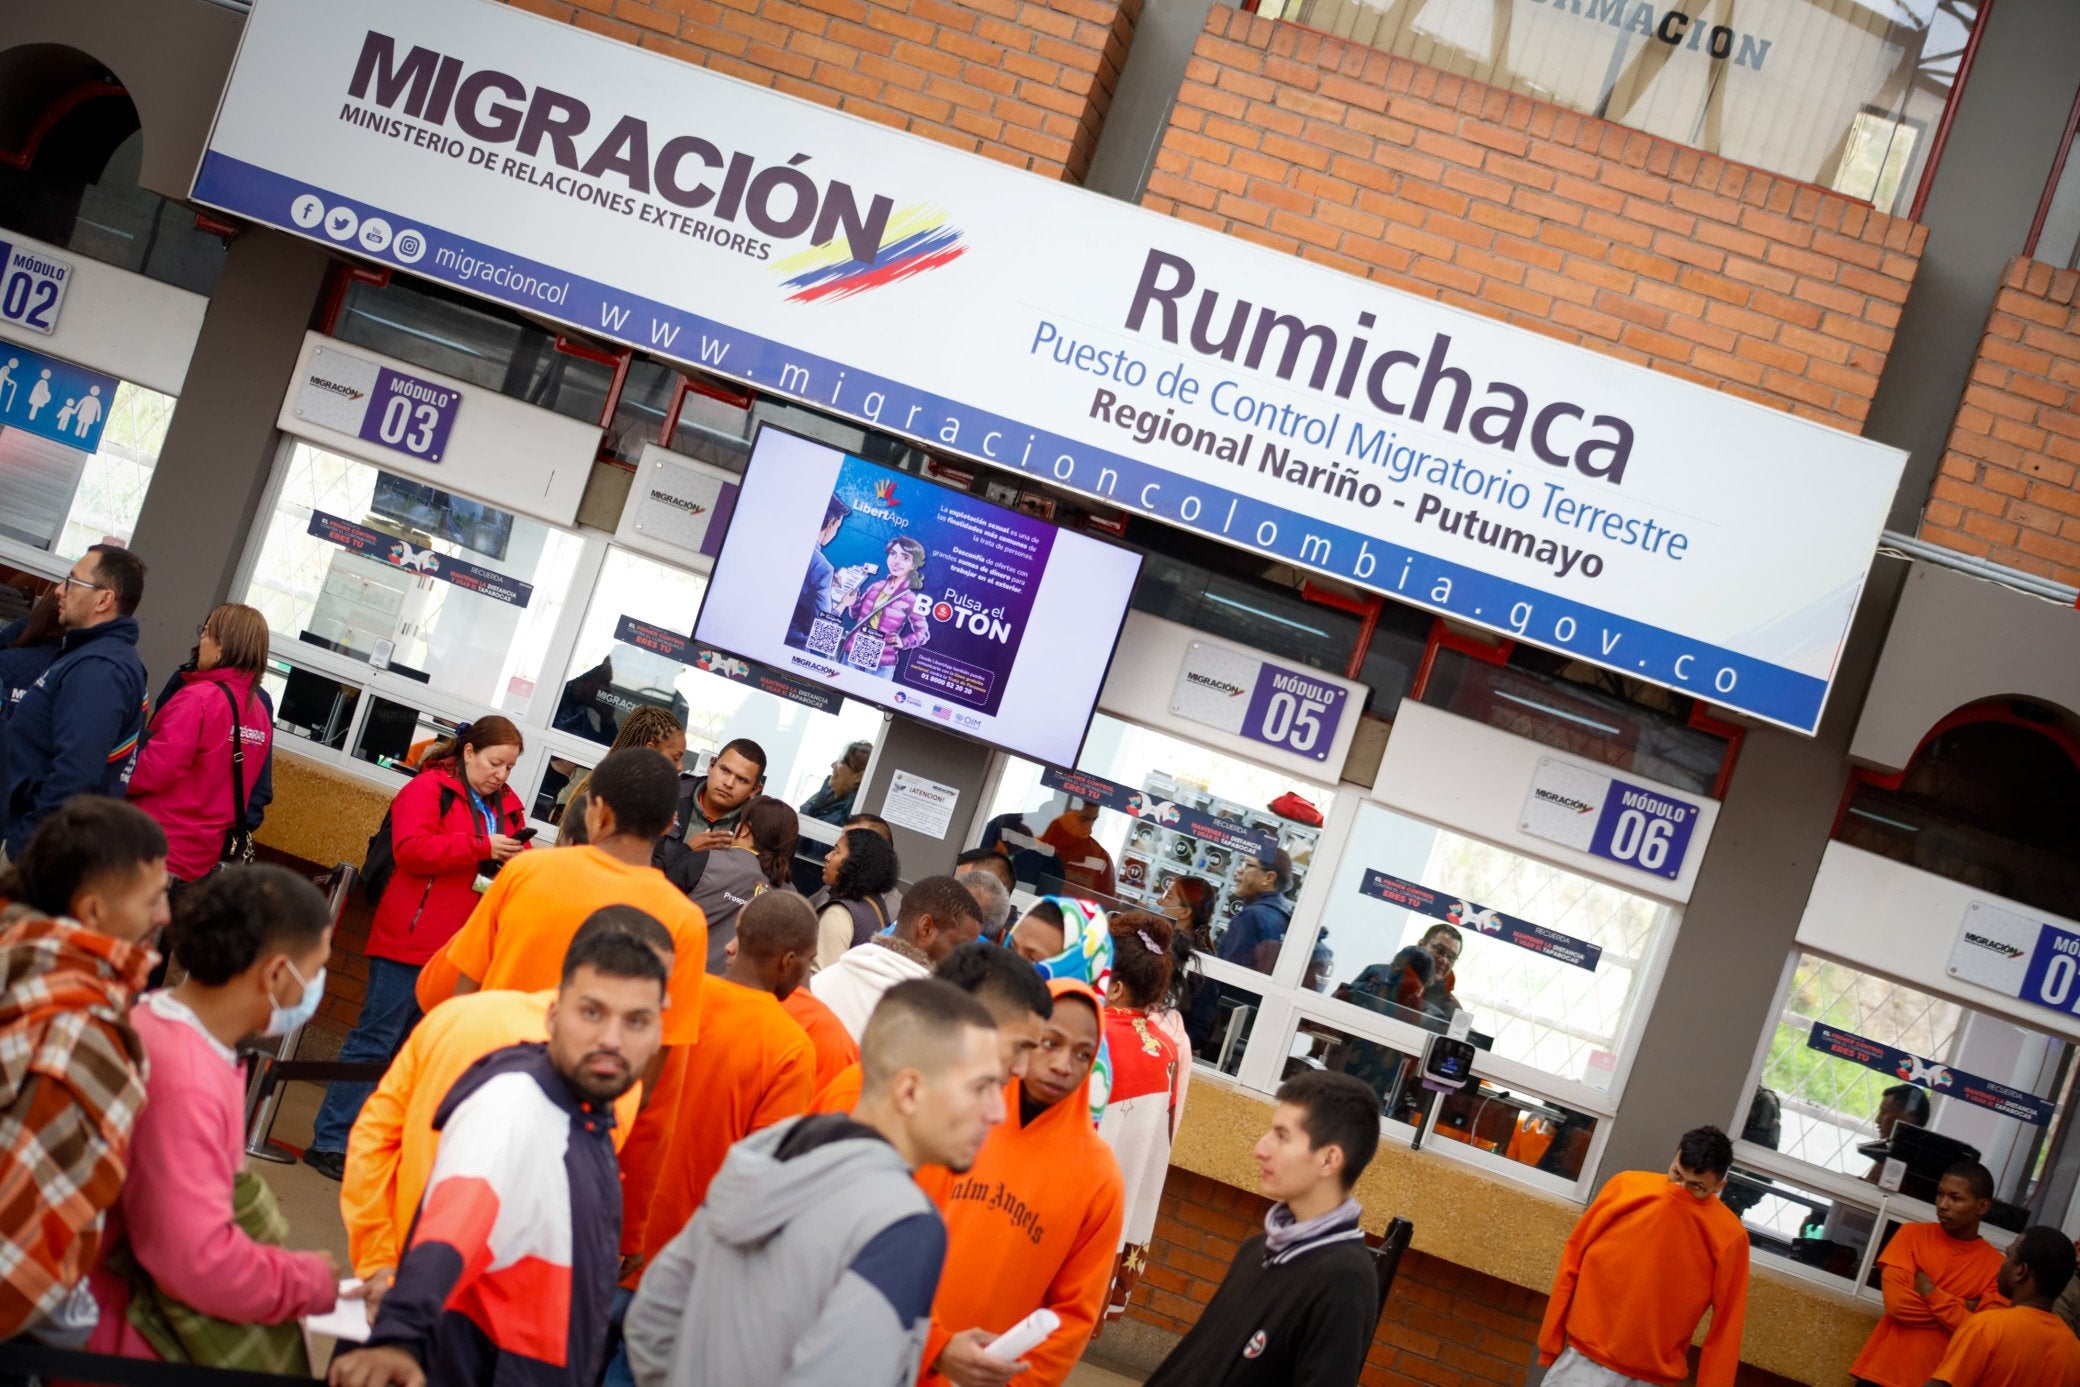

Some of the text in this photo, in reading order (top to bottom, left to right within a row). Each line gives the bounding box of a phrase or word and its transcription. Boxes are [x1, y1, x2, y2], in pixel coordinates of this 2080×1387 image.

[348, 31, 894, 265] MIGRACIÓN
[339, 104, 771, 263] MINISTERIO DE RELACIONES EXTERIORES
[13, 254, 65, 282] MÓDULO
[435, 246, 570, 305] migracioncol
[2, 271, 58, 329] 02
[1125, 247, 1634, 485] Rumichaca
[310, 376, 358, 398] MIGRACIÓN
[390, 377, 448, 408] MÓDULO
[380, 395, 439, 453] 03
[1031, 320, 1689, 562] Puesto de Control Migratorio Terrestre
[1090, 389, 1251, 466] Regional
[1259, 445, 1382, 509] Nariño
[1415, 493, 1604, 579] Putumayo
[650, 489, 700, 511] MIGRACIÓN
[851, 499, 910, 529] LibertApp
[936, 513, 946, 521] las
[946, 516, 983, 534] finalidades
[983, 529, 998, 539] más
[998, 535, 1027, 549] comunes
[948, 507, 987, 527] explotación
[987, 521, 1010, 534] sexual
[1018, 533, 1030, 541] una
[1030, 536, 1040, 544] de
[328, 530, 351, 544] ERES
[979, 538, 994, 547] trata
[994, 542, 1003, 550] de
[1003, 546, 1033, 561] personas.
[931, 548, 1025, 586] grandes sumas de dinero para
[952, 546, 1028, 577] Desconfía de ofertas con
[470, 566, 503, 582] RECUERDA
[949, 564, 977, 580] trabajar
[977, 574, 986, 582] en
[994, 579, 1023, 594] exterior.
[476, 586, 510, 602] TAPABOCAS
[486, 583, 516, 598] DISTANCIA
[943, 588, 1006, 620] Pulsa el
[635, 635, 658, 649] ERES
[791, 656, 835, 676] MIGRACIÓN
[1187, 672, 1239, 693] MIGRACIÓN
[1272, 673, 1335, 705] MÓDULO
[787, 692, 822, 708] TAPABOCAS
[797, 689, 828, 704] DISTANCIA
[1262, 692, 1325, 751] 05
[1062, 781, 1086, 794] ERES
[1535, 788, 1587, 810] MIGRACIÓN
[1622, 790, 1685, 822] MÓDULO
[1212, 818, 1247, 835] RECUERDA
[1220, 838, 1256, 854] TAPABOCAS
[1229, 835, 1261, 850] DISTANCIA
[1610, 809, 1674, 869] 06
[1382, 889, 1406, 903] ERES
[1534, 927, 1570, 944] RECUERDA
[1964, 932, 2018, 954] MIGRACIÓN
[1542, 947, 1578, 963] TAPABOCAS
[1552, 944, 1584, 959] DISTANCIA
[1830, 1043, 1855, 1057] ERES
[1986, 1082, 2022, 1099] RECUERDA
[1993, 1103, 2031, 1120] TAPABOCAS
[2004, 1100, 2037, 1116] DISTANCIA
